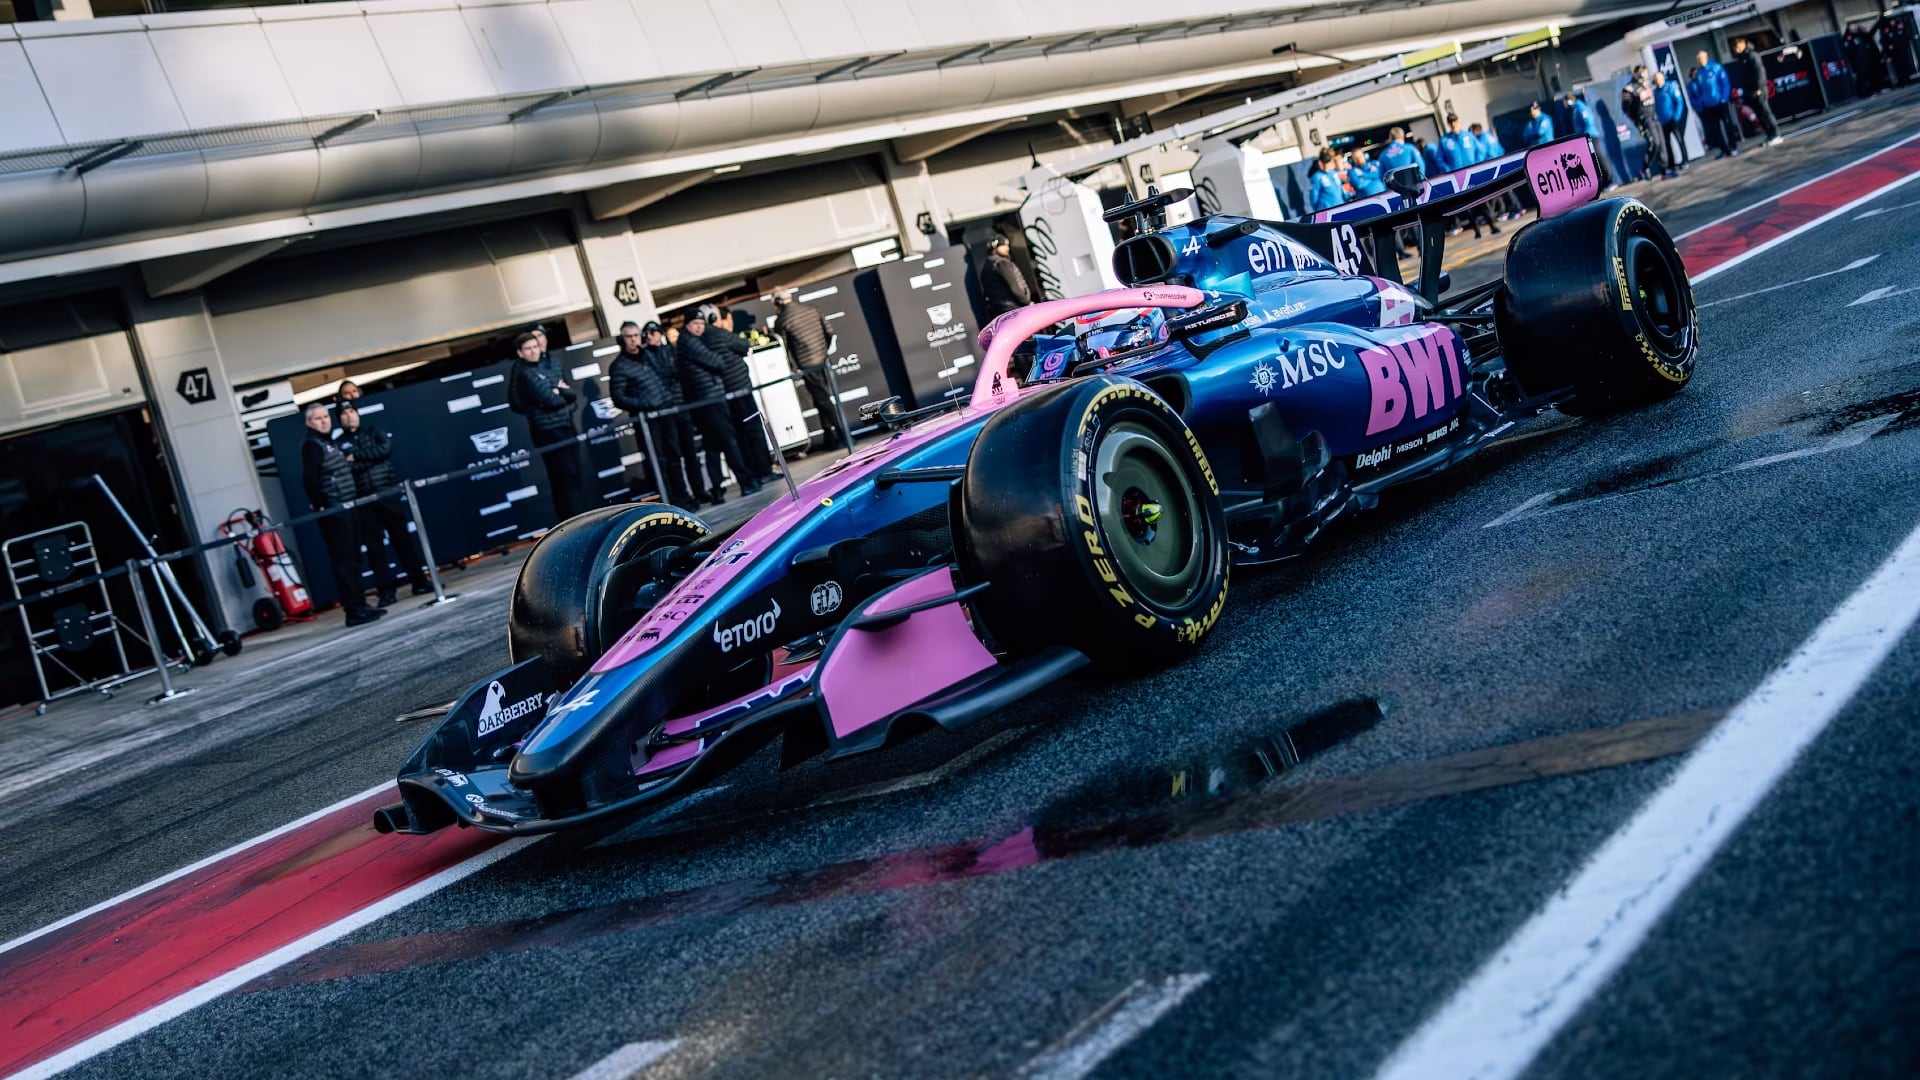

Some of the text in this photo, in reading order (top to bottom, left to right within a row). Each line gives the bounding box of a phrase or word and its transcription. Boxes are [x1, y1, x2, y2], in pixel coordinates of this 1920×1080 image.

[1537, 160, 1565, 195] eni
[1248, 239, 1287, 274] eni
[1330, 224, 1362, 276] 43
[618, 281, 638, 302] 46
[1276, 338, 1345, 389] MSC
[1358, 322, 1462, 437] BWT
[184, 373, 209, 399] 47
[1356, 444, 1392, 469] Delphi
[1074, 494, 1157, 629] P ZERO
[478, 692, 543, 734] OAKBERRY
